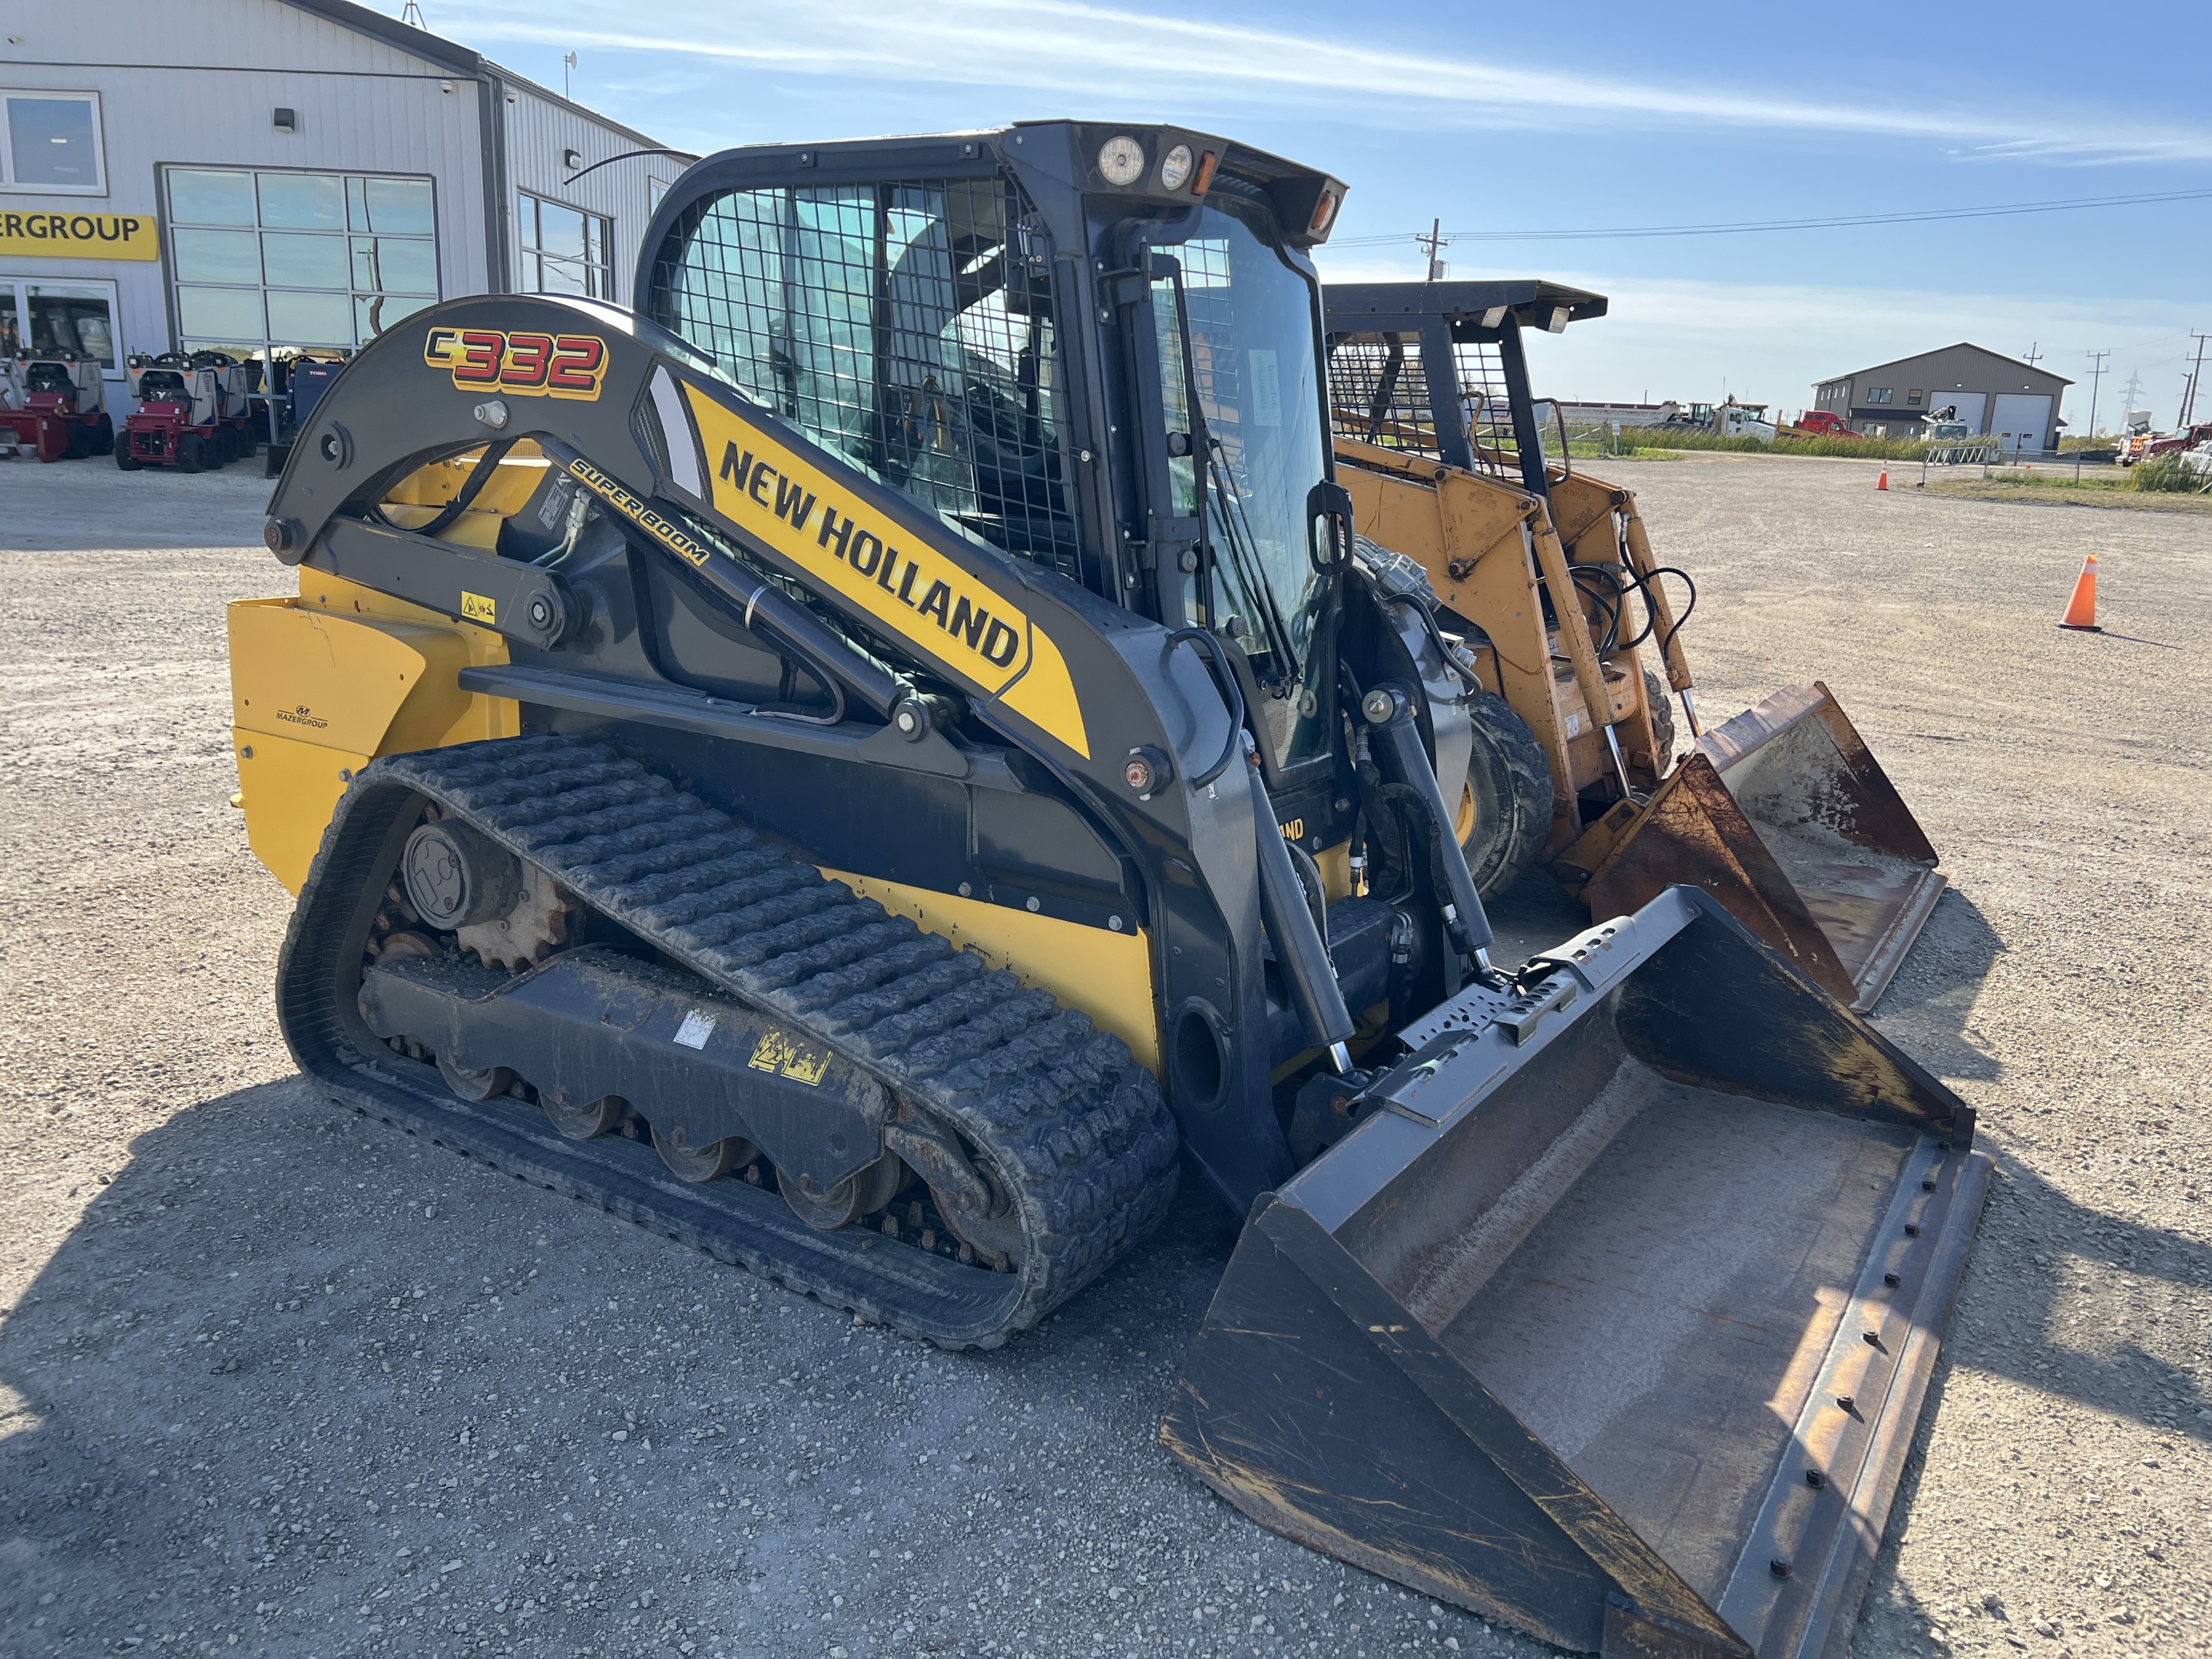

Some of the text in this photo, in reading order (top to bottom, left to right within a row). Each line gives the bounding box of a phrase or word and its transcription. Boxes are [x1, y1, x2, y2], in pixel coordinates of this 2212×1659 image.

[0, 214, 140, 241] RGROUP
[424, 327, 608, 399] C332
[570, 459, 644, 518] SUPER
[639, 510, 710, 566] BOOM
[718, 439, 1019, 669] NEW HOLLAND
[276, 712, 328, 730] MAZERGROUP
